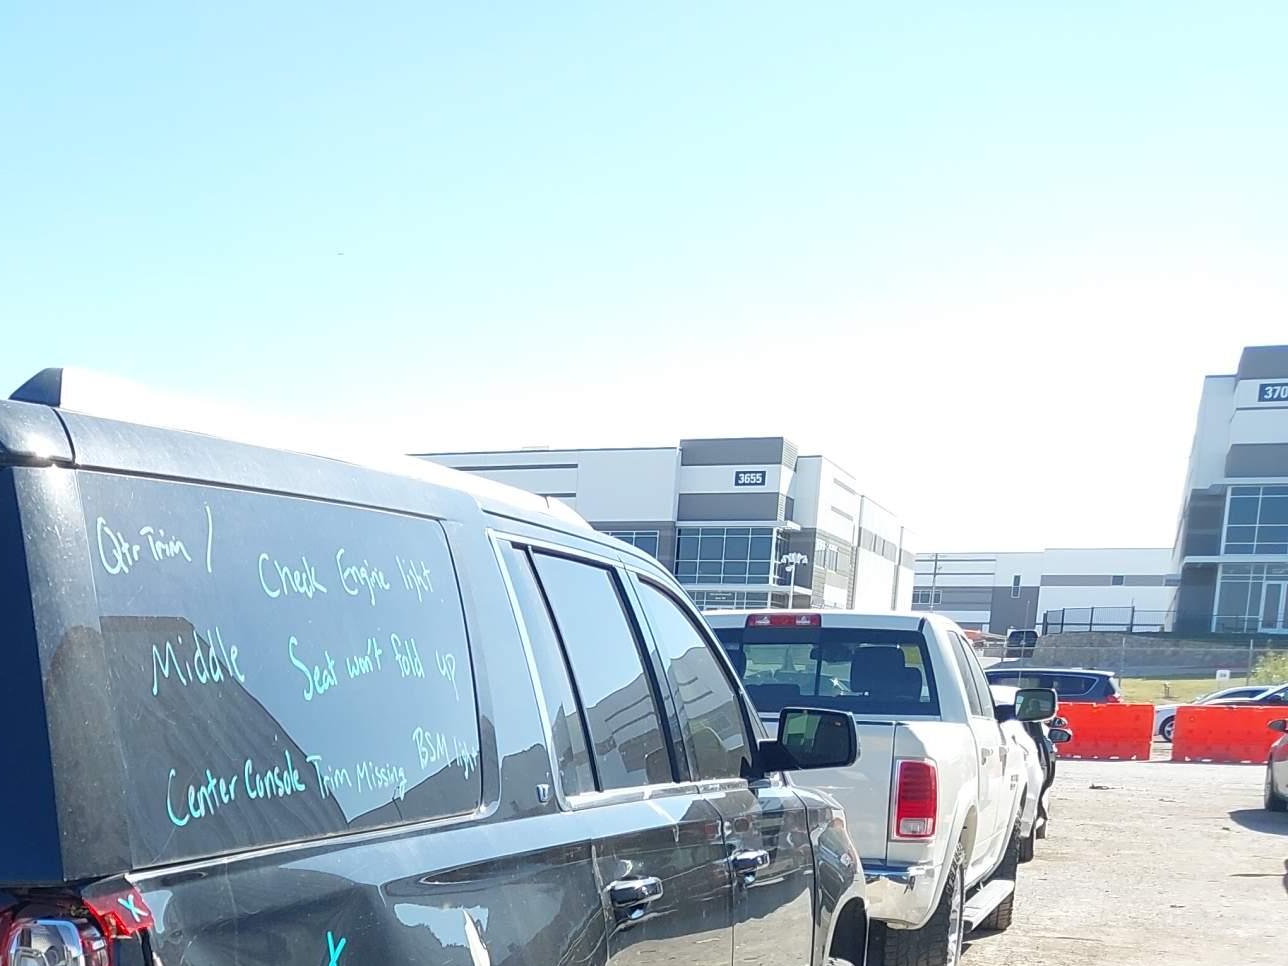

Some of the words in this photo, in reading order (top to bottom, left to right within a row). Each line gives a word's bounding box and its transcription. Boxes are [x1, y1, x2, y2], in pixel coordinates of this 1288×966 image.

[737, 473, 763, 484] 3655
[139, 526, 192, 562] Trim
[258, 552, 328, 599] Check
[336, 548, 390, 606] Engine
[395, 555, 433, 603] light
[152, 626, 245, 696] Middle
[289, 635, 338, 701] Seat
[346, 637, 393, 679] won't
[391, 633, 425, 678] fold
[436, 648, 460, 702] up
[412, 726, 452, 771] BSM
[167, 768, 238, 827] Center
[244, 750, 306, 799] Console
[306, 755, 353, 799] Trim
[356, 760, 408, 801] Missing
